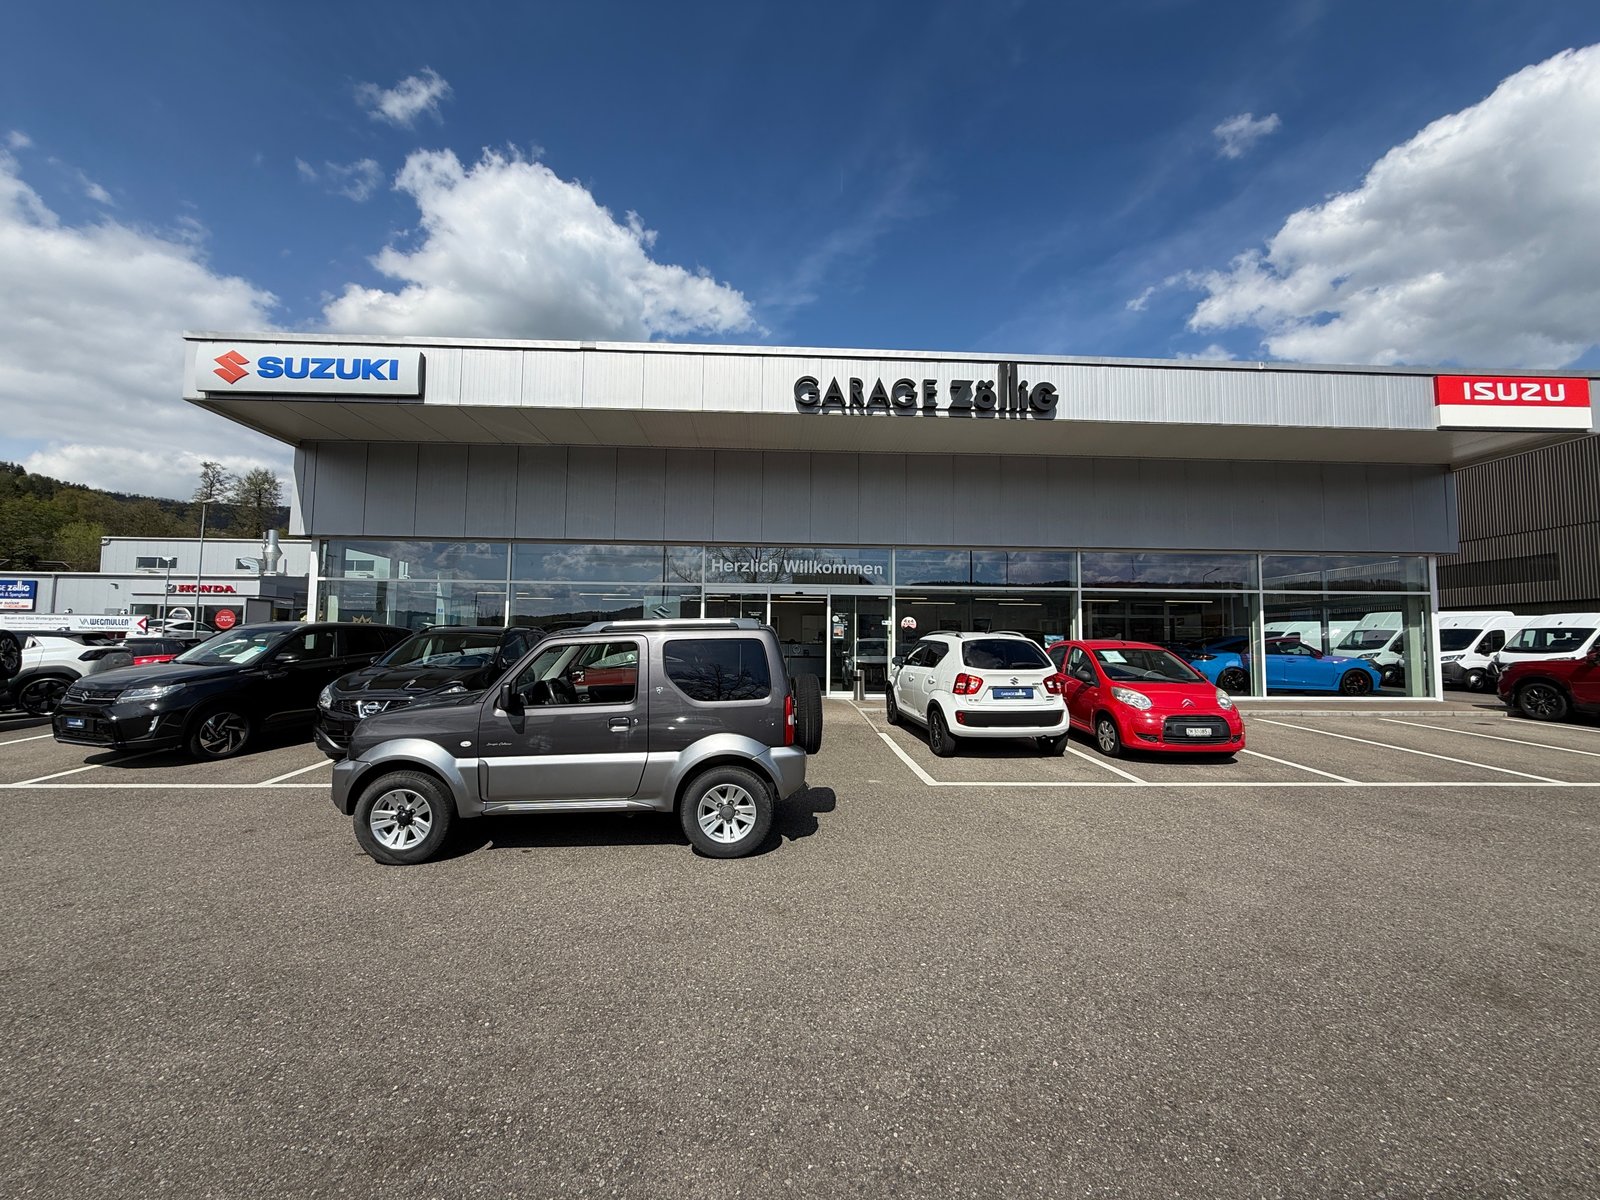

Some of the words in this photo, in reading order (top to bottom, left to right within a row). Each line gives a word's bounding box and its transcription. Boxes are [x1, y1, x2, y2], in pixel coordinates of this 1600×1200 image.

[257, 356, 399, 381] SUZUKI
[794, 375, 938, 409] GARAGE
[1463, 382, 1566, 402] ISUZU
[711, 559, 778, 573] Herzlich
[784, 560, 883, 575] Willkommen
[178, 584, 237, 594] HONDA
